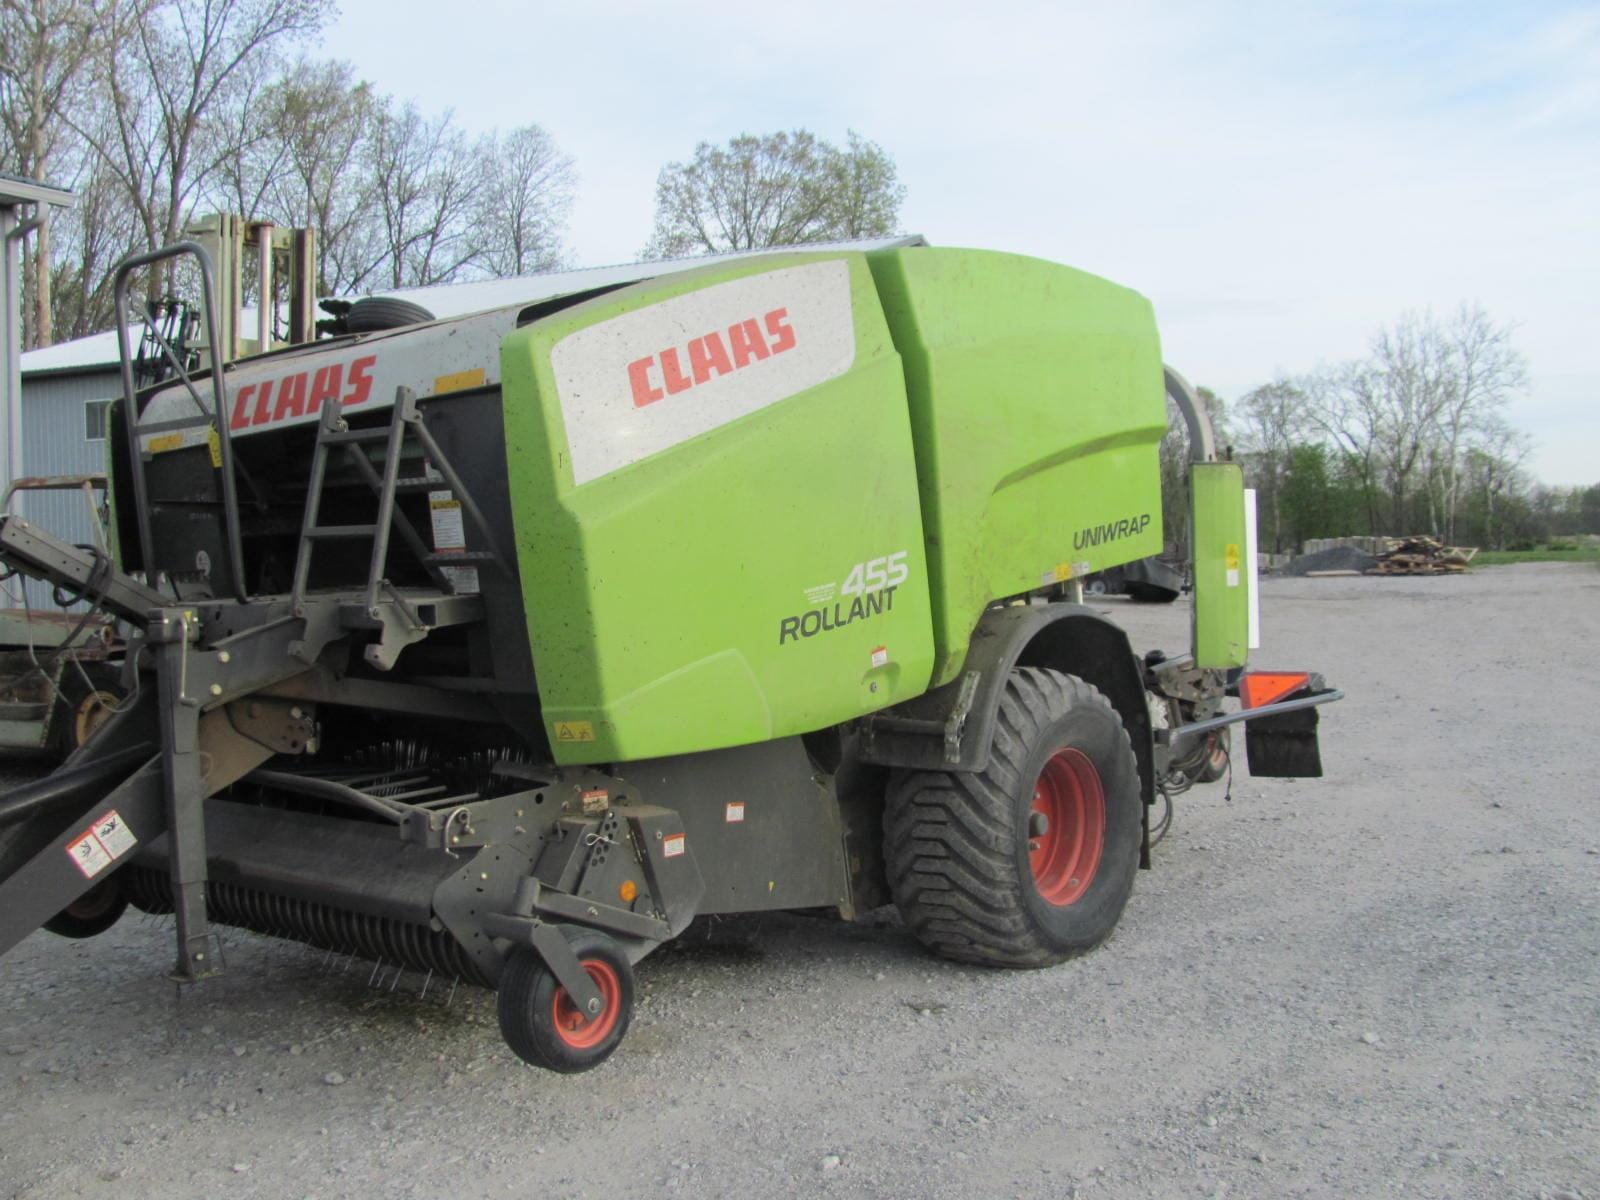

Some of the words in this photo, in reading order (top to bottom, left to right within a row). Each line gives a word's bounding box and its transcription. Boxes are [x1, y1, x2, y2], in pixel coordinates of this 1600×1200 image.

[627, 307, 796, 408] CLAAS
[231, 355, 376, 430] CLAAS
[1073, 514, 1150, 550] UNIWRAP
[840, 550, 909, 597] 455
[779, 586, 898, 645] ROLLANT
